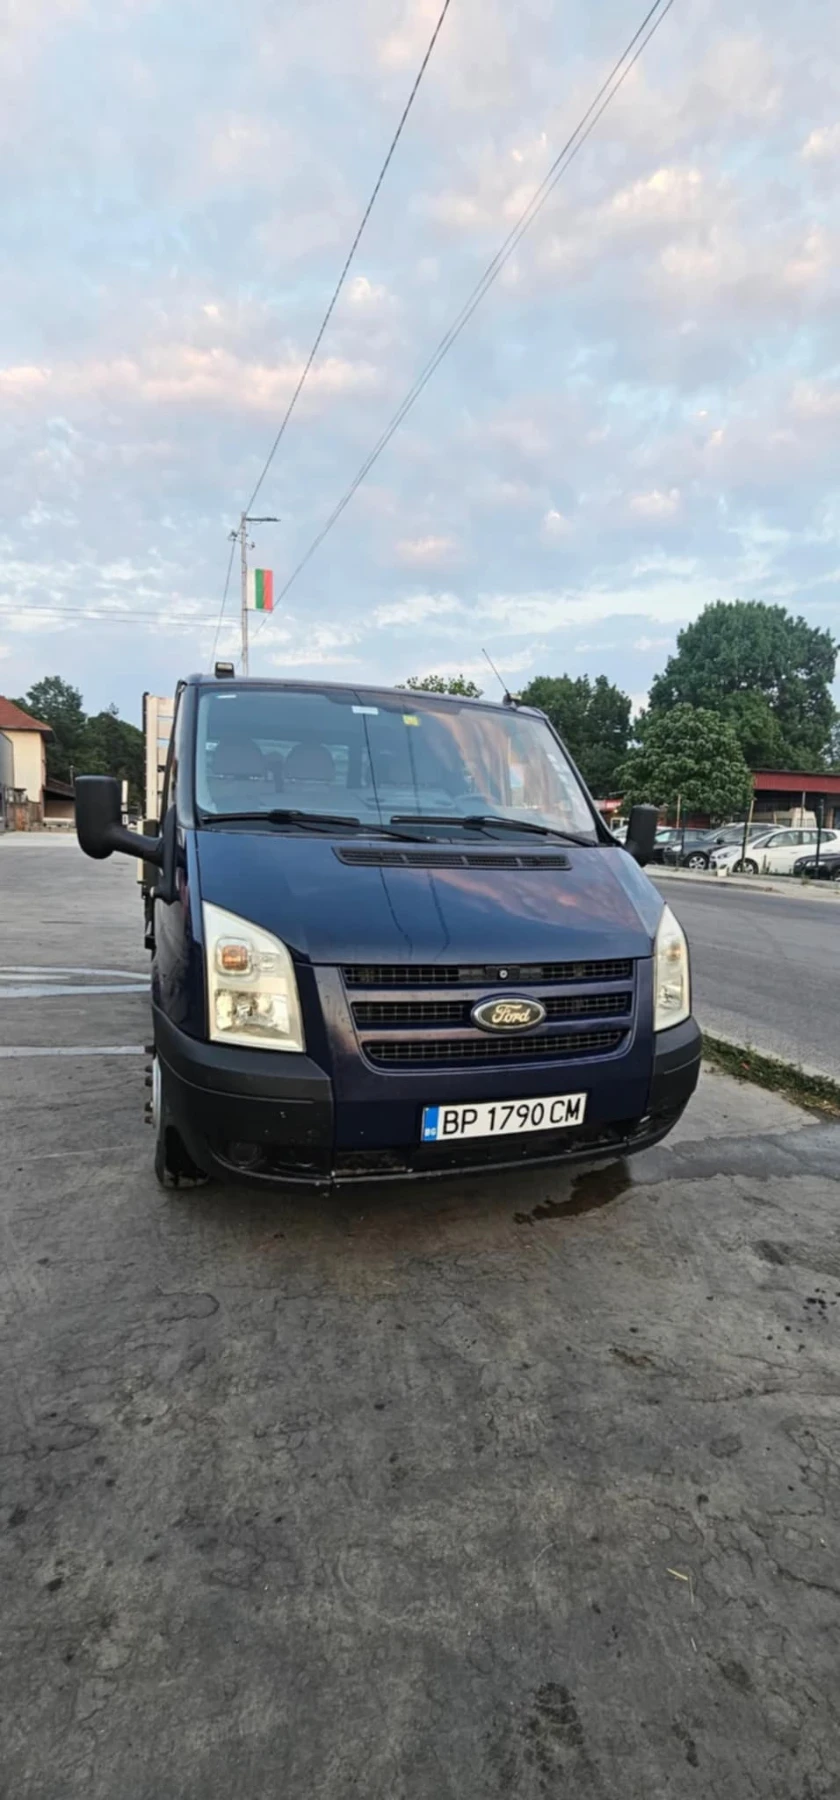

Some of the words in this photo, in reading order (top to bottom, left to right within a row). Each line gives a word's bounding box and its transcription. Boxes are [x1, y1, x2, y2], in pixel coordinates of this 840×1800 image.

[491, 1004, 531, 1023] Ford
[442, 1109, 477, 1135] BP
[488, 1103, 545, 1131] 1790
[549, 1098, 581, 1124] CM
